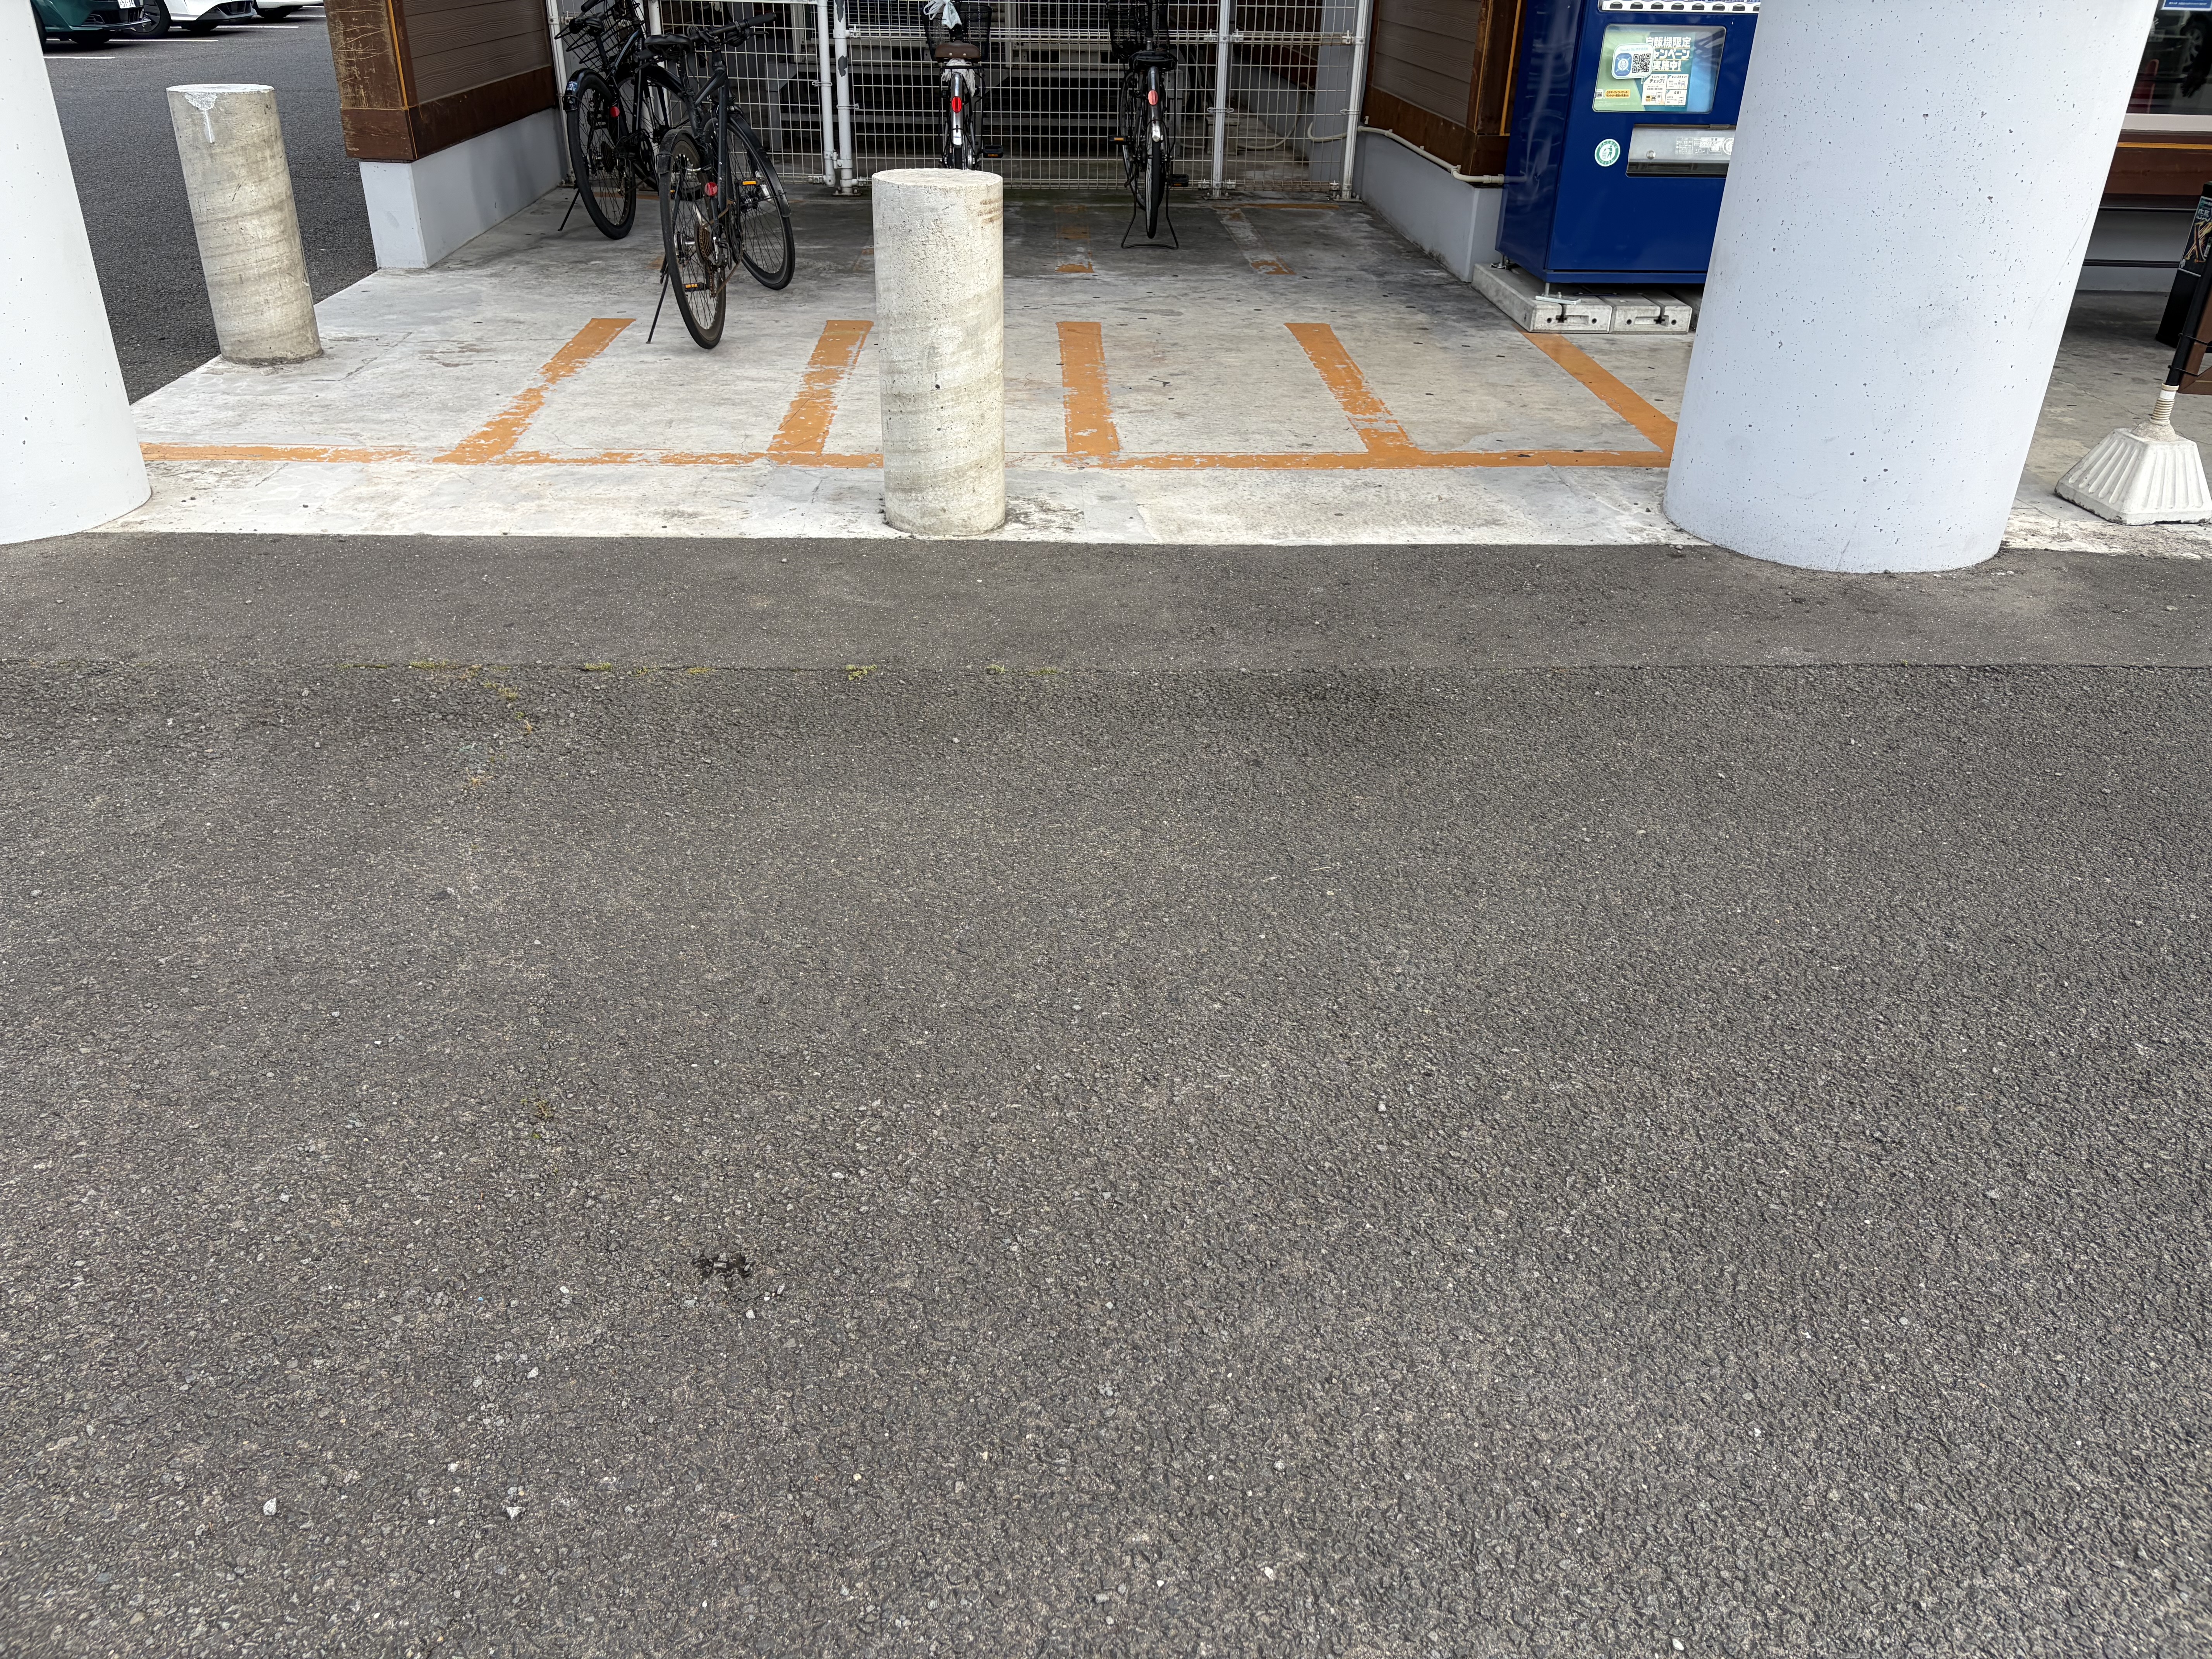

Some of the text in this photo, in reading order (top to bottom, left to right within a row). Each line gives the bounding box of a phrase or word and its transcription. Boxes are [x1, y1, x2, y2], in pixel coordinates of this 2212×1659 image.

[1654, 49, 1690, 59] ャンペーン
